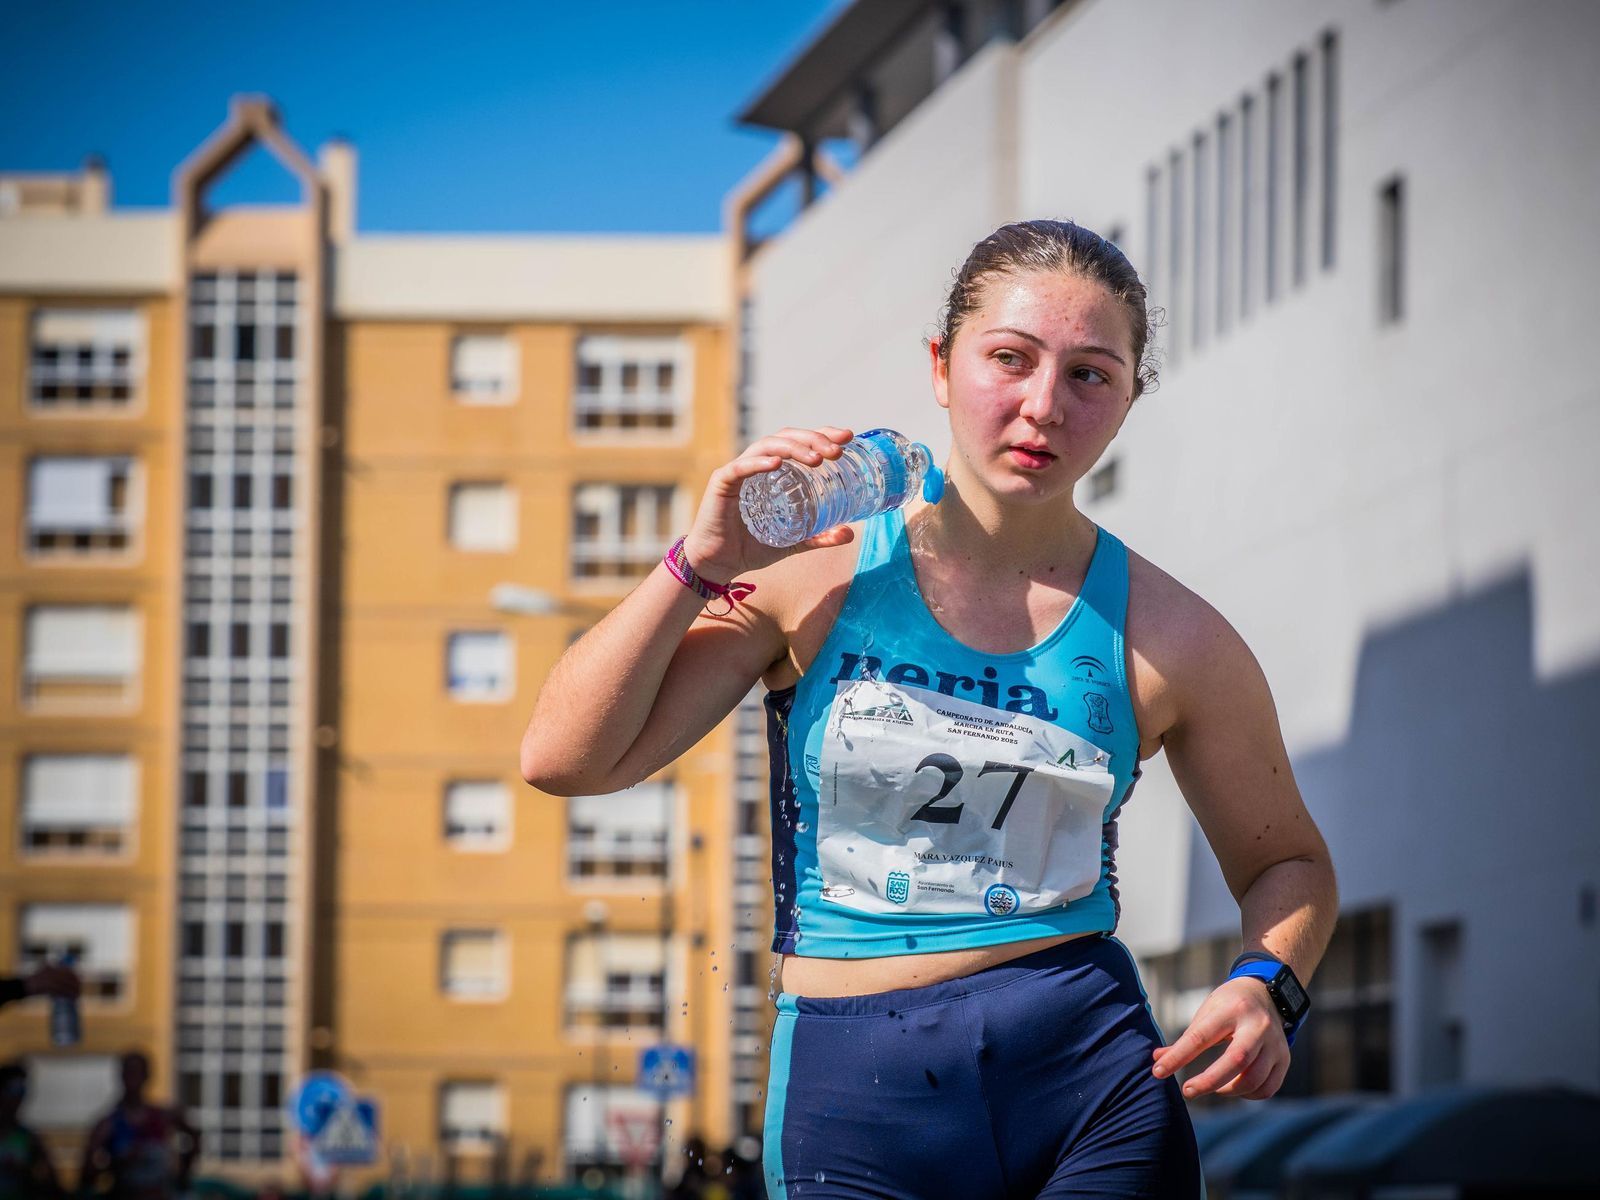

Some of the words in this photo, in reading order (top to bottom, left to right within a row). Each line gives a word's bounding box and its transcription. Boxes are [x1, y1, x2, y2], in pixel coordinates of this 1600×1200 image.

[936, 708, 983, 724] CAMPEONATO
[994, 721, 1033, 735] ANDALUCÍA
[954, 721, 983, 731] MARCHA
[995, 728, 1014, 736] RUTA
[947, 727, 962, 735] SAN
[963, 730, 1000, 741] FERNANDO
[1000, 737, 1018, 745] 2025
[910, 753, 1035, 830] 27
[914, 851, 940, 861] MARA
[942, 854, 986, 864] VAZQUEZ
[928, 886, 955, 894] Fernando
